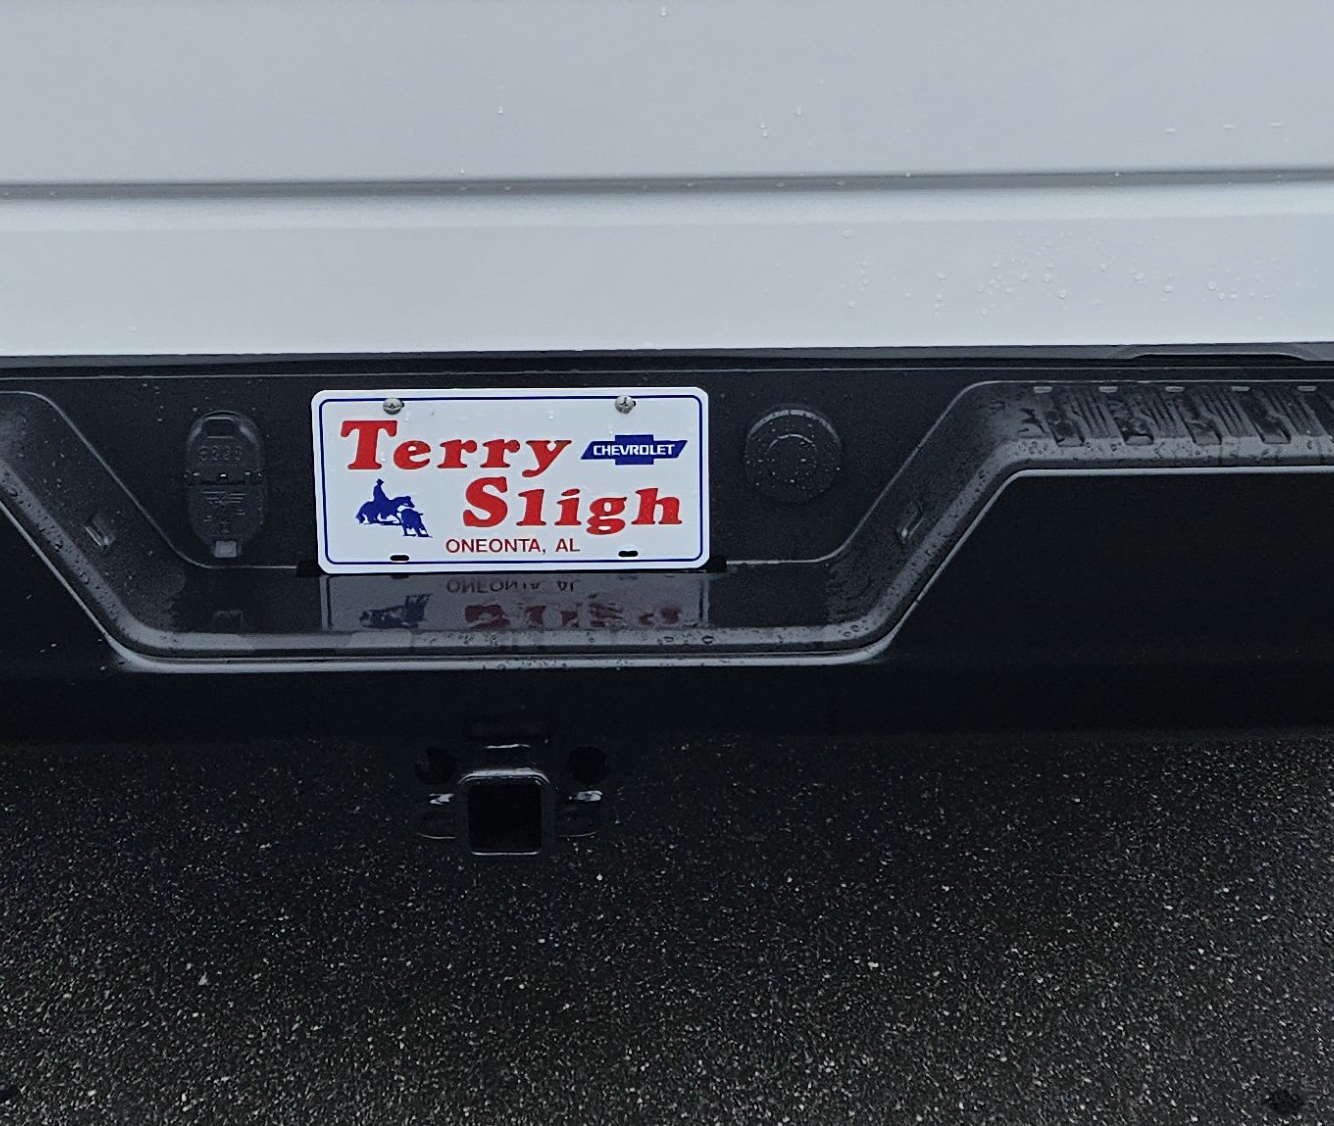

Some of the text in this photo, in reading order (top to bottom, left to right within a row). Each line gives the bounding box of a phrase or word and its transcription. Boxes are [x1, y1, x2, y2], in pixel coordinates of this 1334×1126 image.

[340, 420, 572, 477] Terry
[592, 443, 675, 457] CHEVROLET
[463, 476, 682, 535] Sligh
[445, 537, 580, 555] ONEONTA, AL
